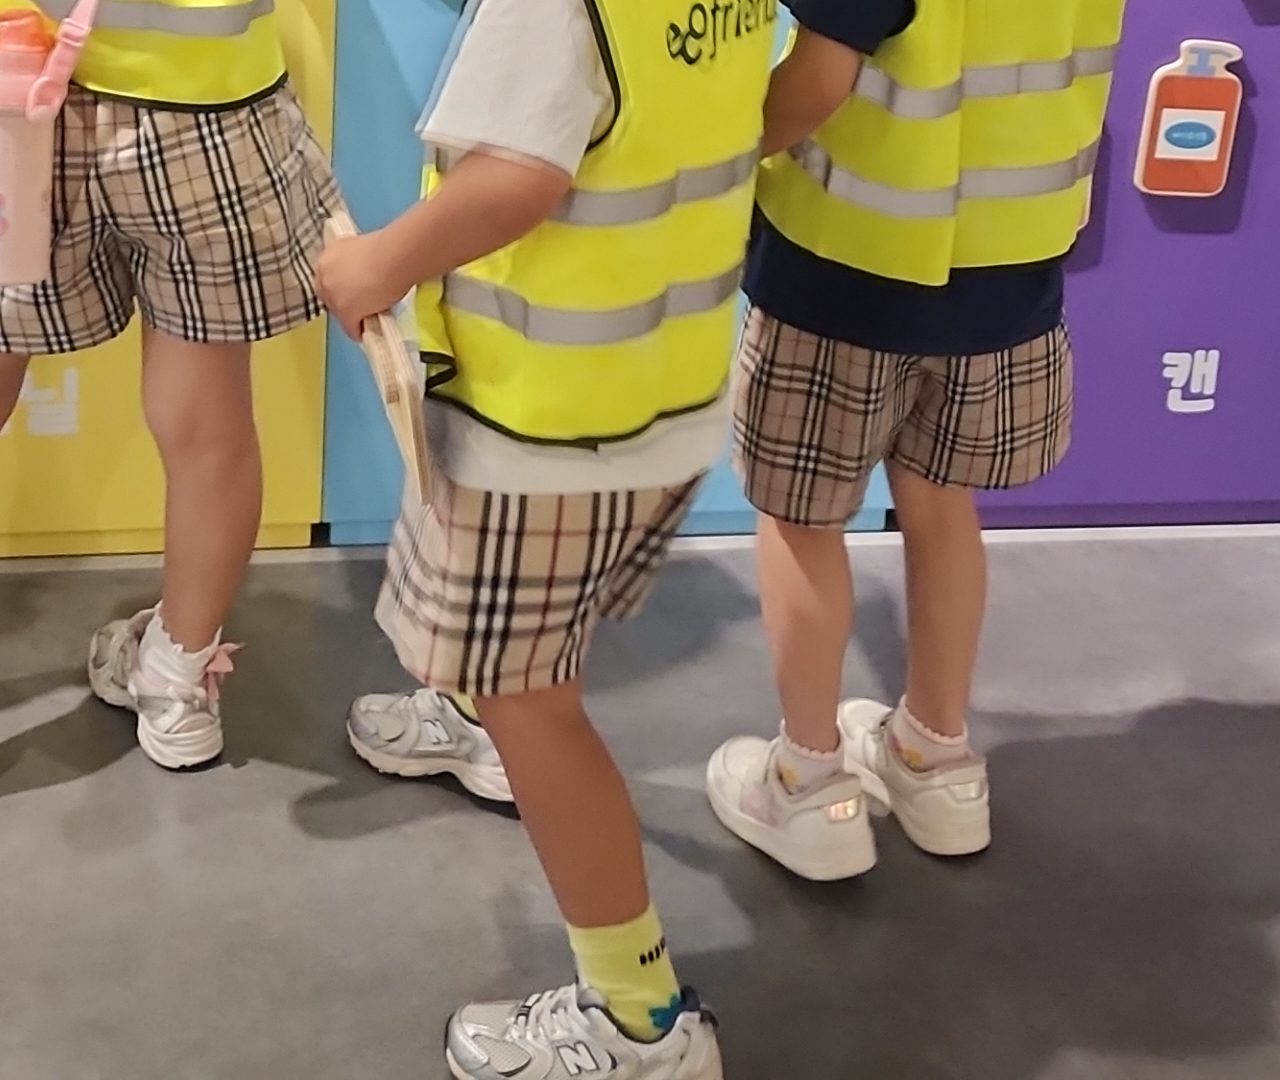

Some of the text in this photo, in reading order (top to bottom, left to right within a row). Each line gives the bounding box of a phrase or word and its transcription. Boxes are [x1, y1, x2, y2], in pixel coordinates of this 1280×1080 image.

[2, 366, 80, 436] 닐
[1161, 348, 1221, 413] 캔
[556, 1039, 601, 1077] N
